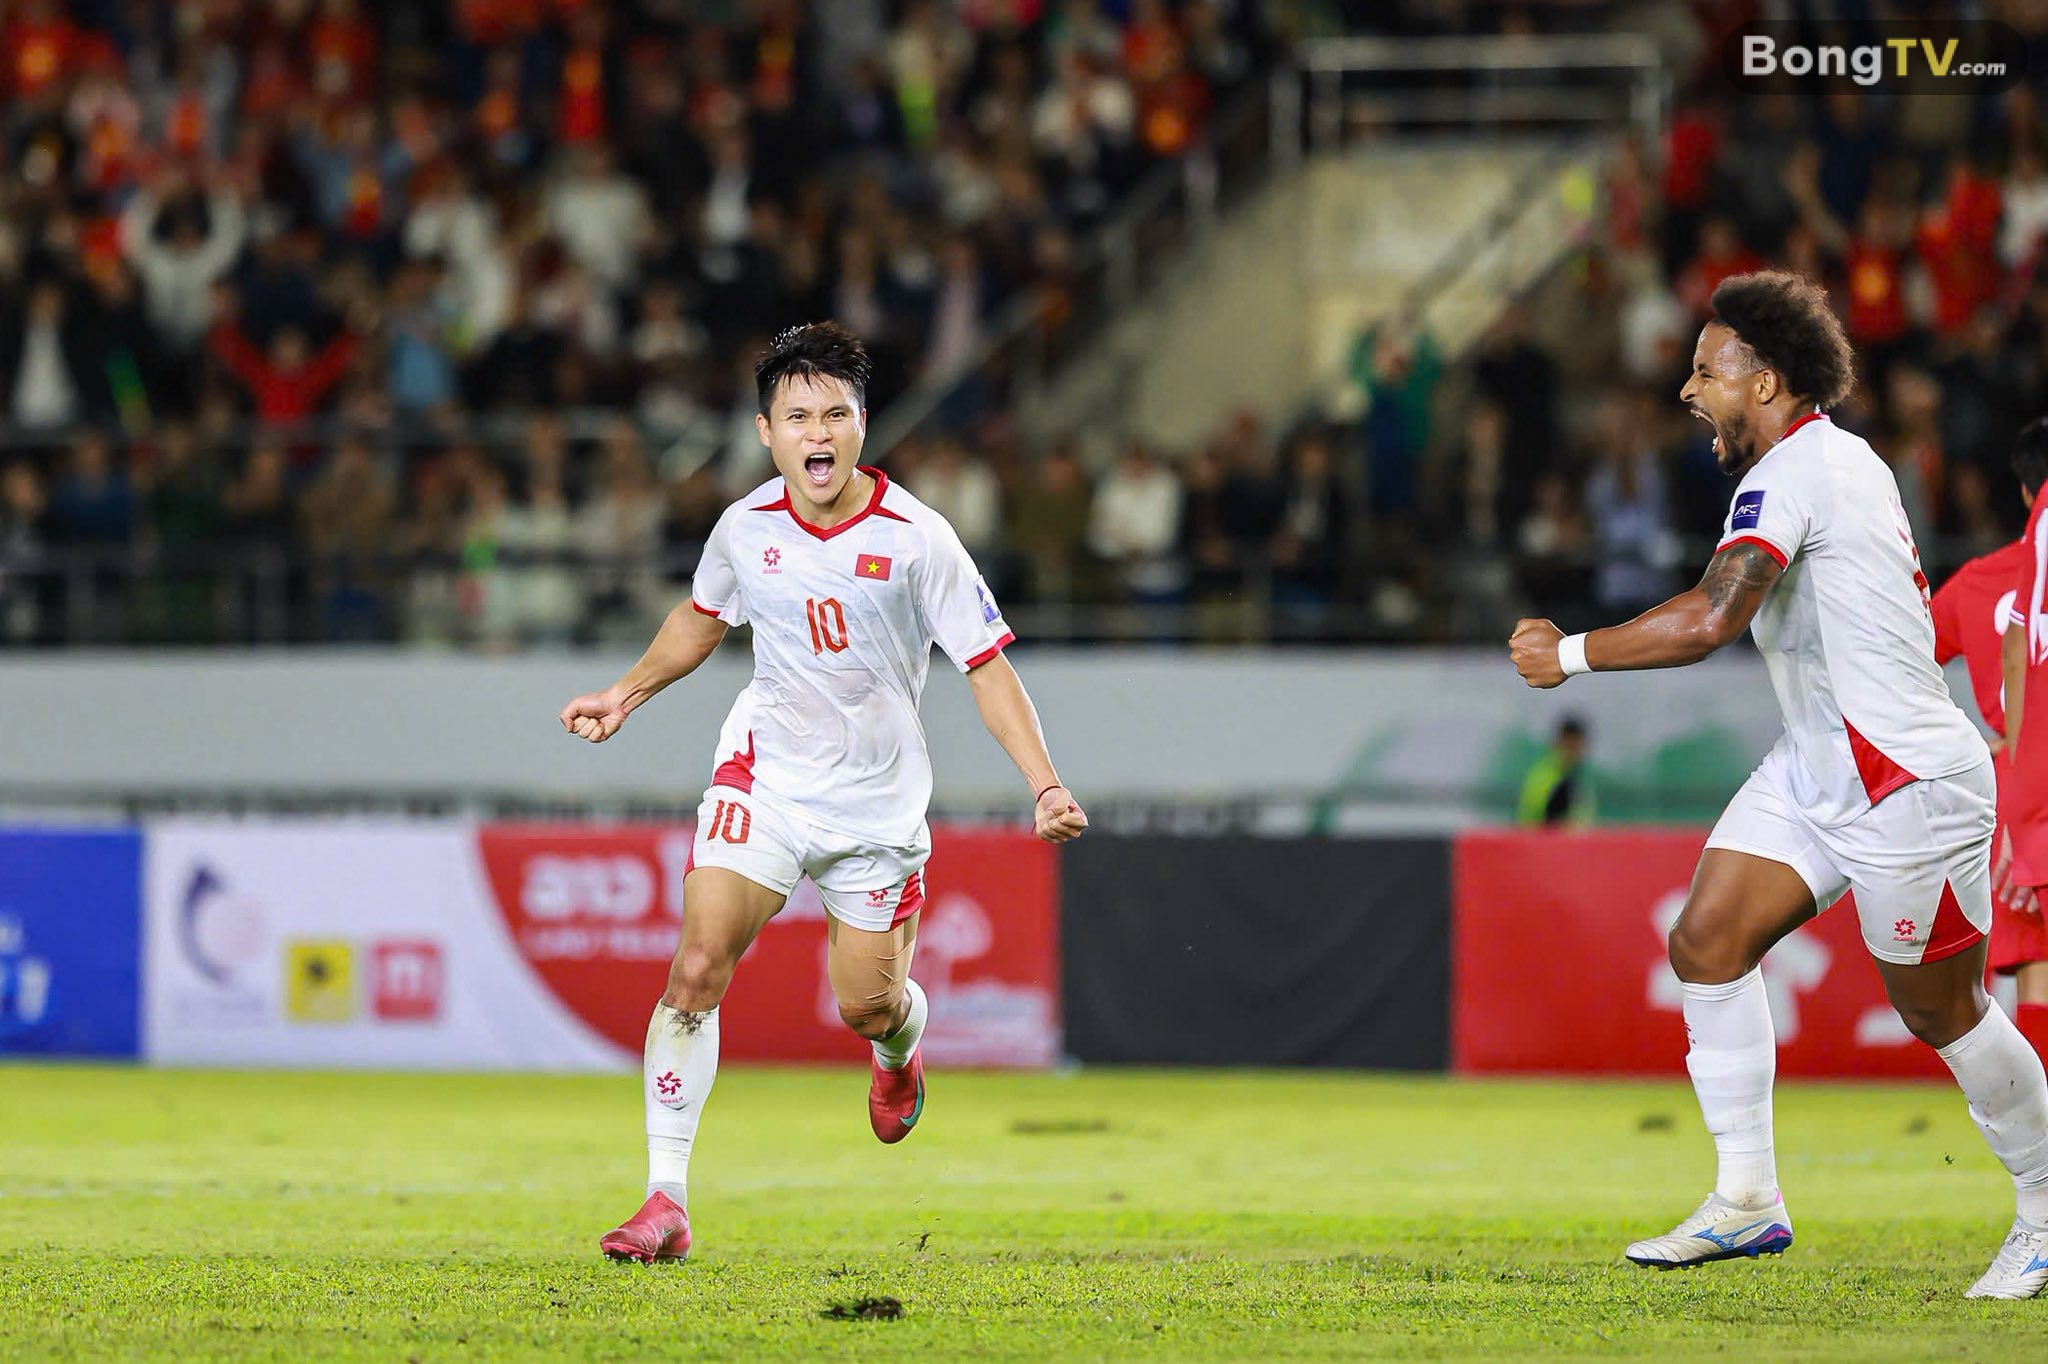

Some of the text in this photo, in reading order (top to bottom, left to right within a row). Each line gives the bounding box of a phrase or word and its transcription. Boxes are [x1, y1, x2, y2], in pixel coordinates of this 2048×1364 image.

[1734, 503, 1761, 516] AFC
[806, 597, 849, 656] 10
[706, 799, 751, 844] 10
